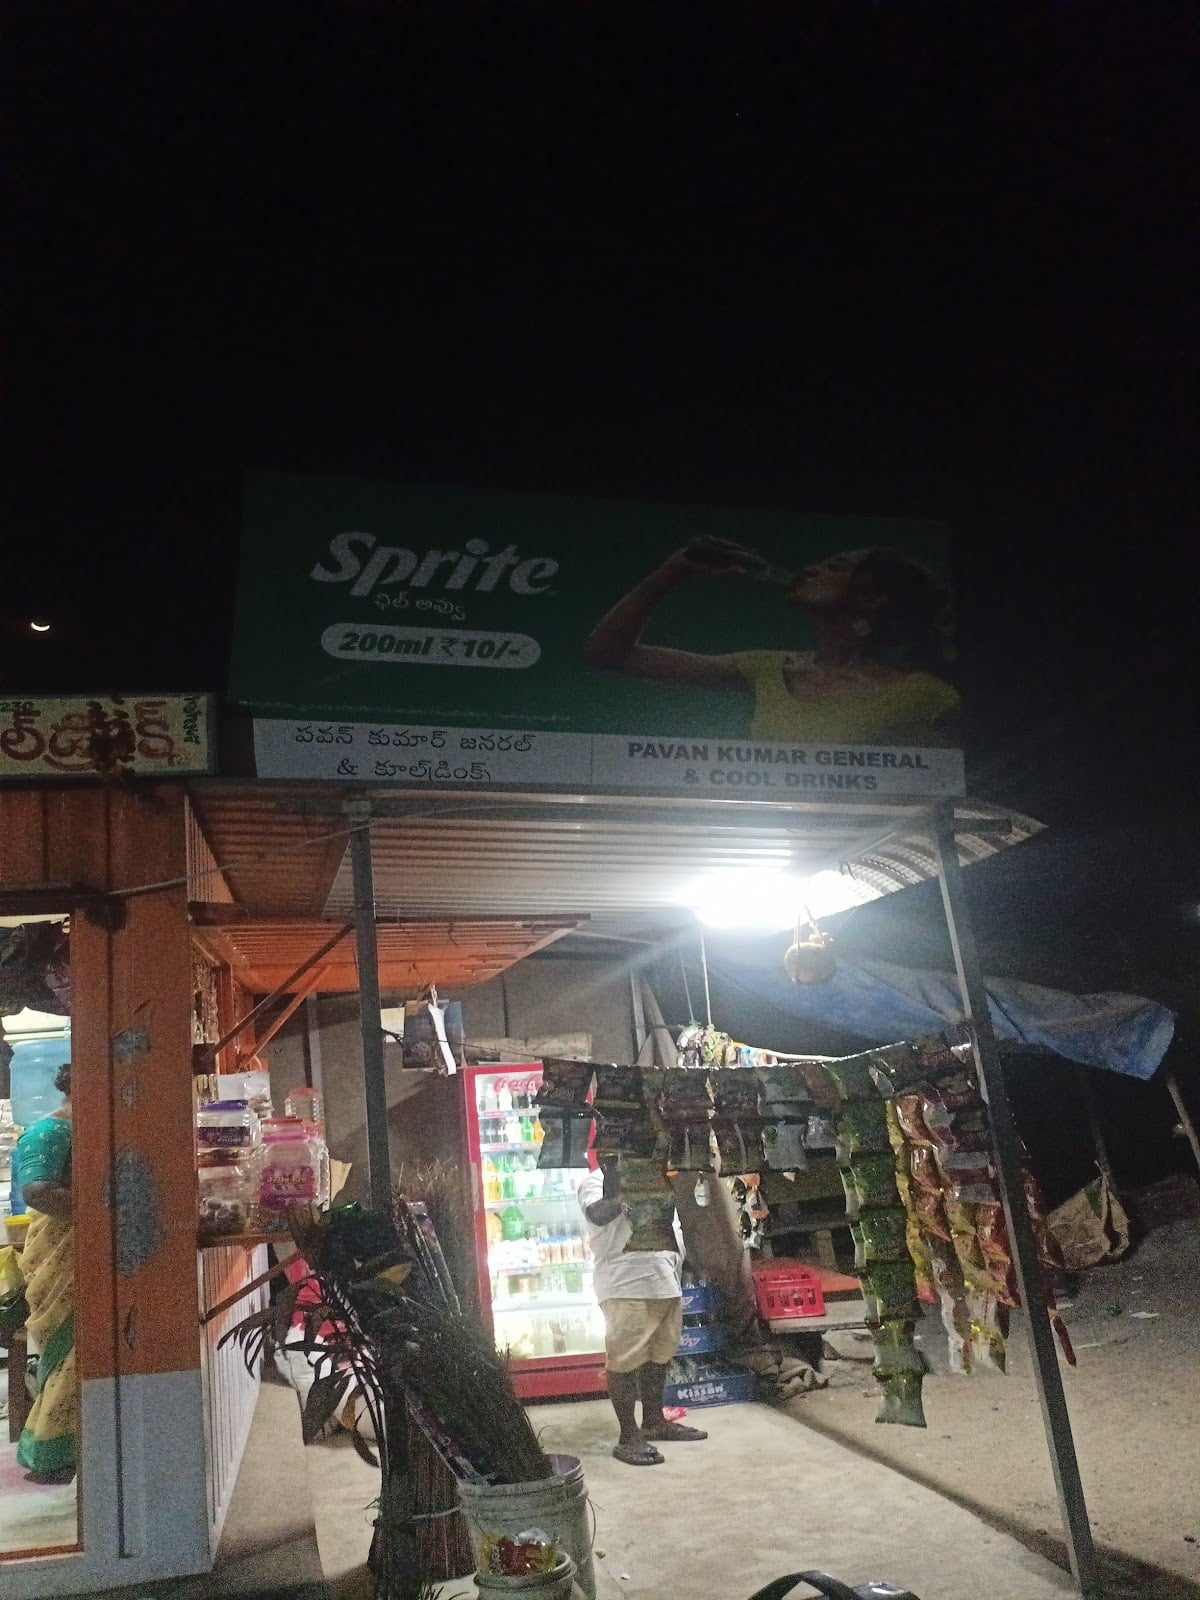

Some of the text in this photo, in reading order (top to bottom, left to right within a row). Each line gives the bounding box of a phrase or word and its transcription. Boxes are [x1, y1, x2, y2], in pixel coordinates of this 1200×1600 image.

[309, 531, 559, 597] Sprite
[339, 632, 434, 655] 200ml
[295, 725, 537, 752] పవన్ కుమార్ జనరల్
[628, 742, 929, 769] PAVAN KUMAR GENERAL
[683, 768, 878, 791] & COOL DRINKS
